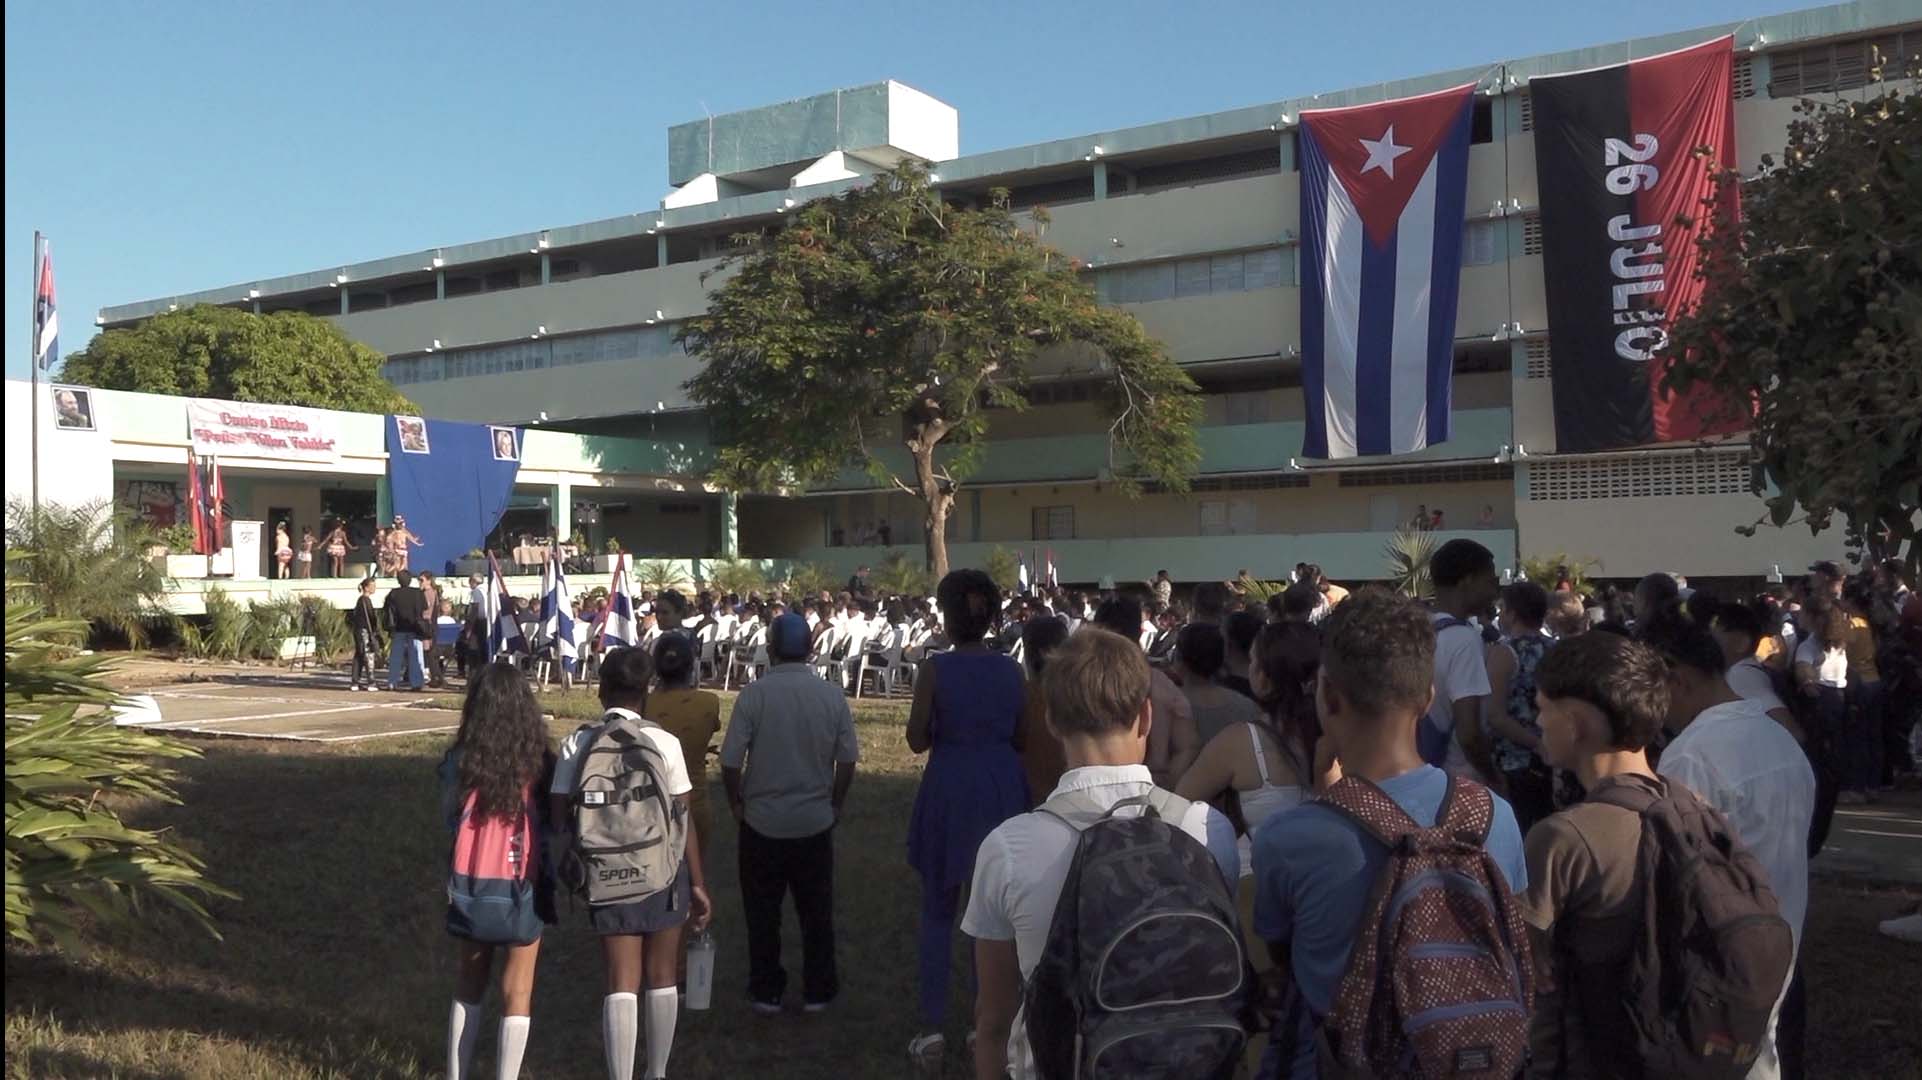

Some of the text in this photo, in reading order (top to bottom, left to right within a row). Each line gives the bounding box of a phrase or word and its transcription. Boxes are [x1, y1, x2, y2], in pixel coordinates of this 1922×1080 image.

[1604, 133, 1669, 362] 26 JULIO
[599, 863, 651, 881] SPORT
